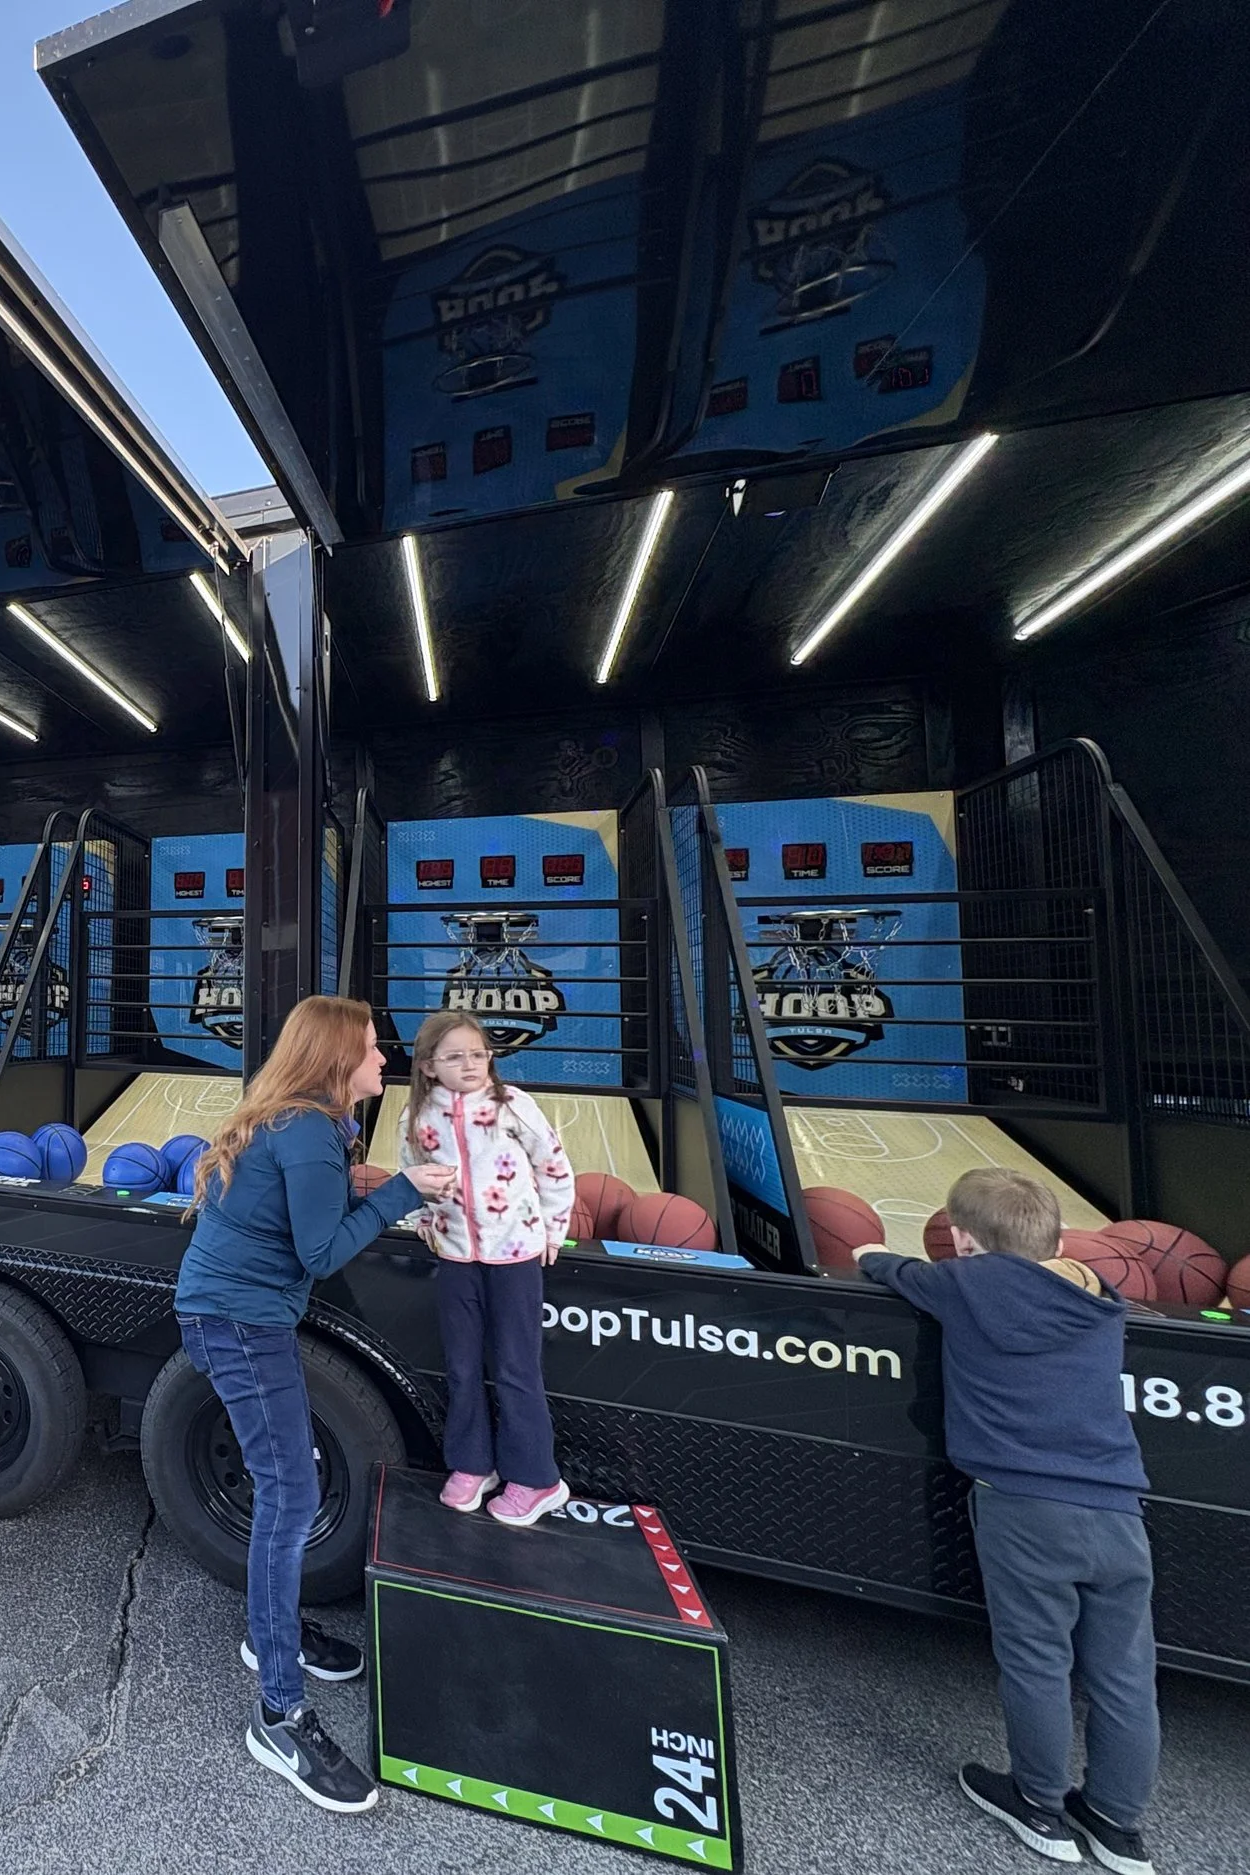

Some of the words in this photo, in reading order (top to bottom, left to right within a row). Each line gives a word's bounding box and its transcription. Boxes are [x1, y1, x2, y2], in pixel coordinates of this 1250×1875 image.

[791, 868, 819, 878] TIME
[866, 865, 910, 875] SCORE
[418, 879, 452, 887] HIGHEST
[486, 878, 510, 887] TIME
[546, 875, 581, 884] SCORE
[175, 889, 204, 897] HIGHEST
[231, 889, 244, 897] TIM
[195, 987, 243, 1015] HO
[448, 988, 560, 1016] HOOP
[757, 991, 886, 1018] HOOP
[789, 1027, 833, 1035] TULSA
[542, 1302, 902, 1380] oopTulsa.com
[1120, 1373, 1246, 1428] 18.8
[566, 1500, 635, 1527] 20
[651, 1726, 715, 1760] INCH
[651, 1752, 719, 1832] 24
